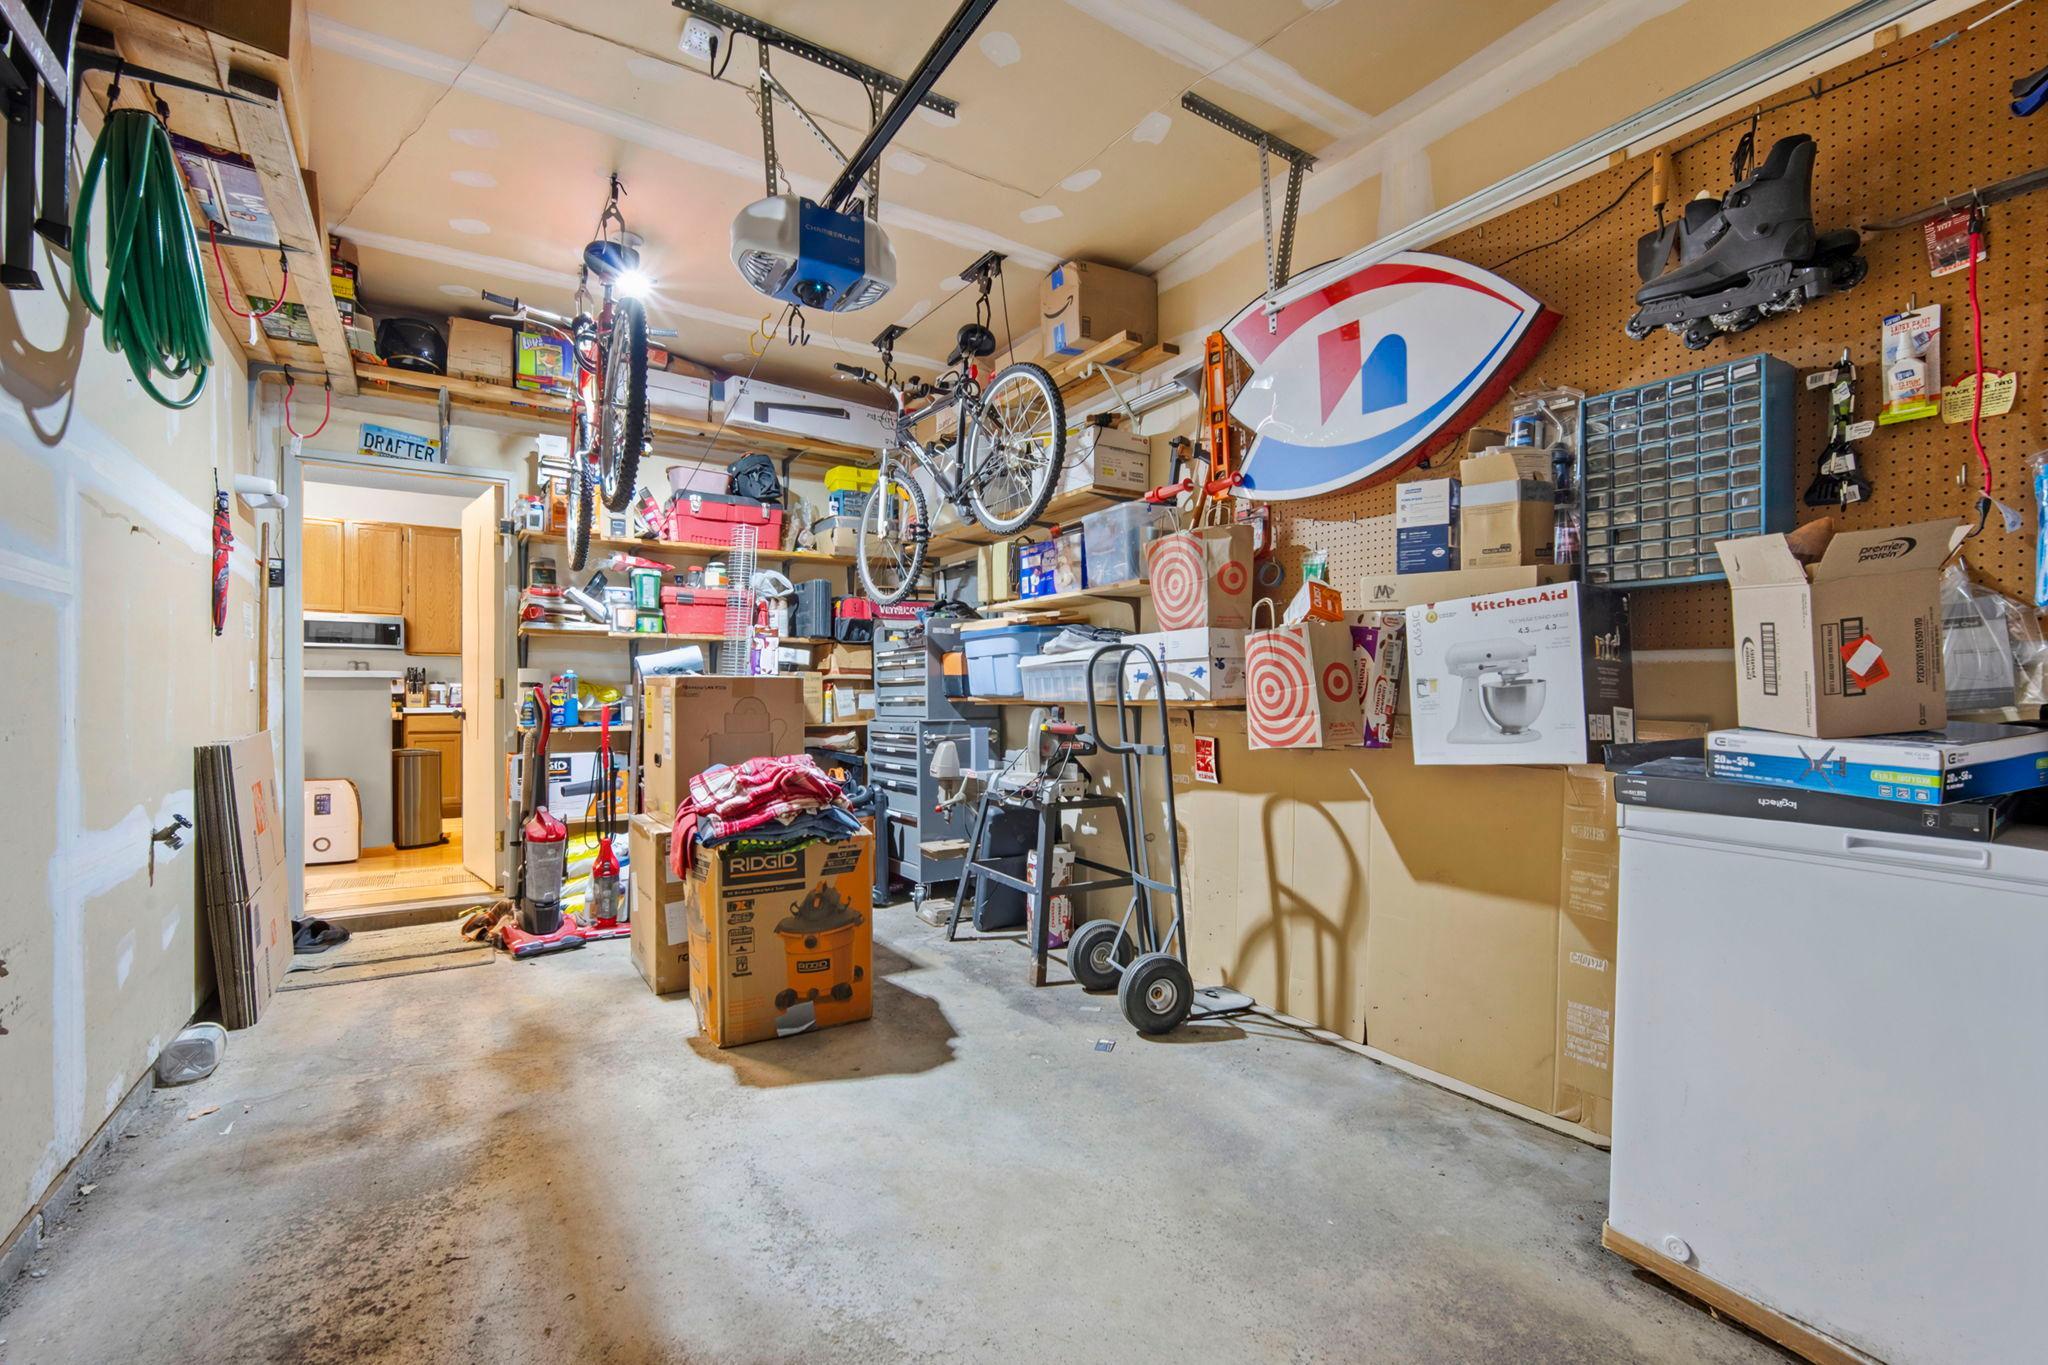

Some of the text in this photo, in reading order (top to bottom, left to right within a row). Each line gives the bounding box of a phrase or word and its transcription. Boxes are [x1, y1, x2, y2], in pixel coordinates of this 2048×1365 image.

[363, 432, 435, 462] DRAFTER
[1858, 551, 1898, 564] protein
[1859, 542, 1905, 557] premier
[1471, 588, 1569, 612] KitchenAid
[1411, 610, 1424, 656] CLASSIC
[1758, 798, 1797, 809] logitech
[730, 853, 798, 873] RIDGID
